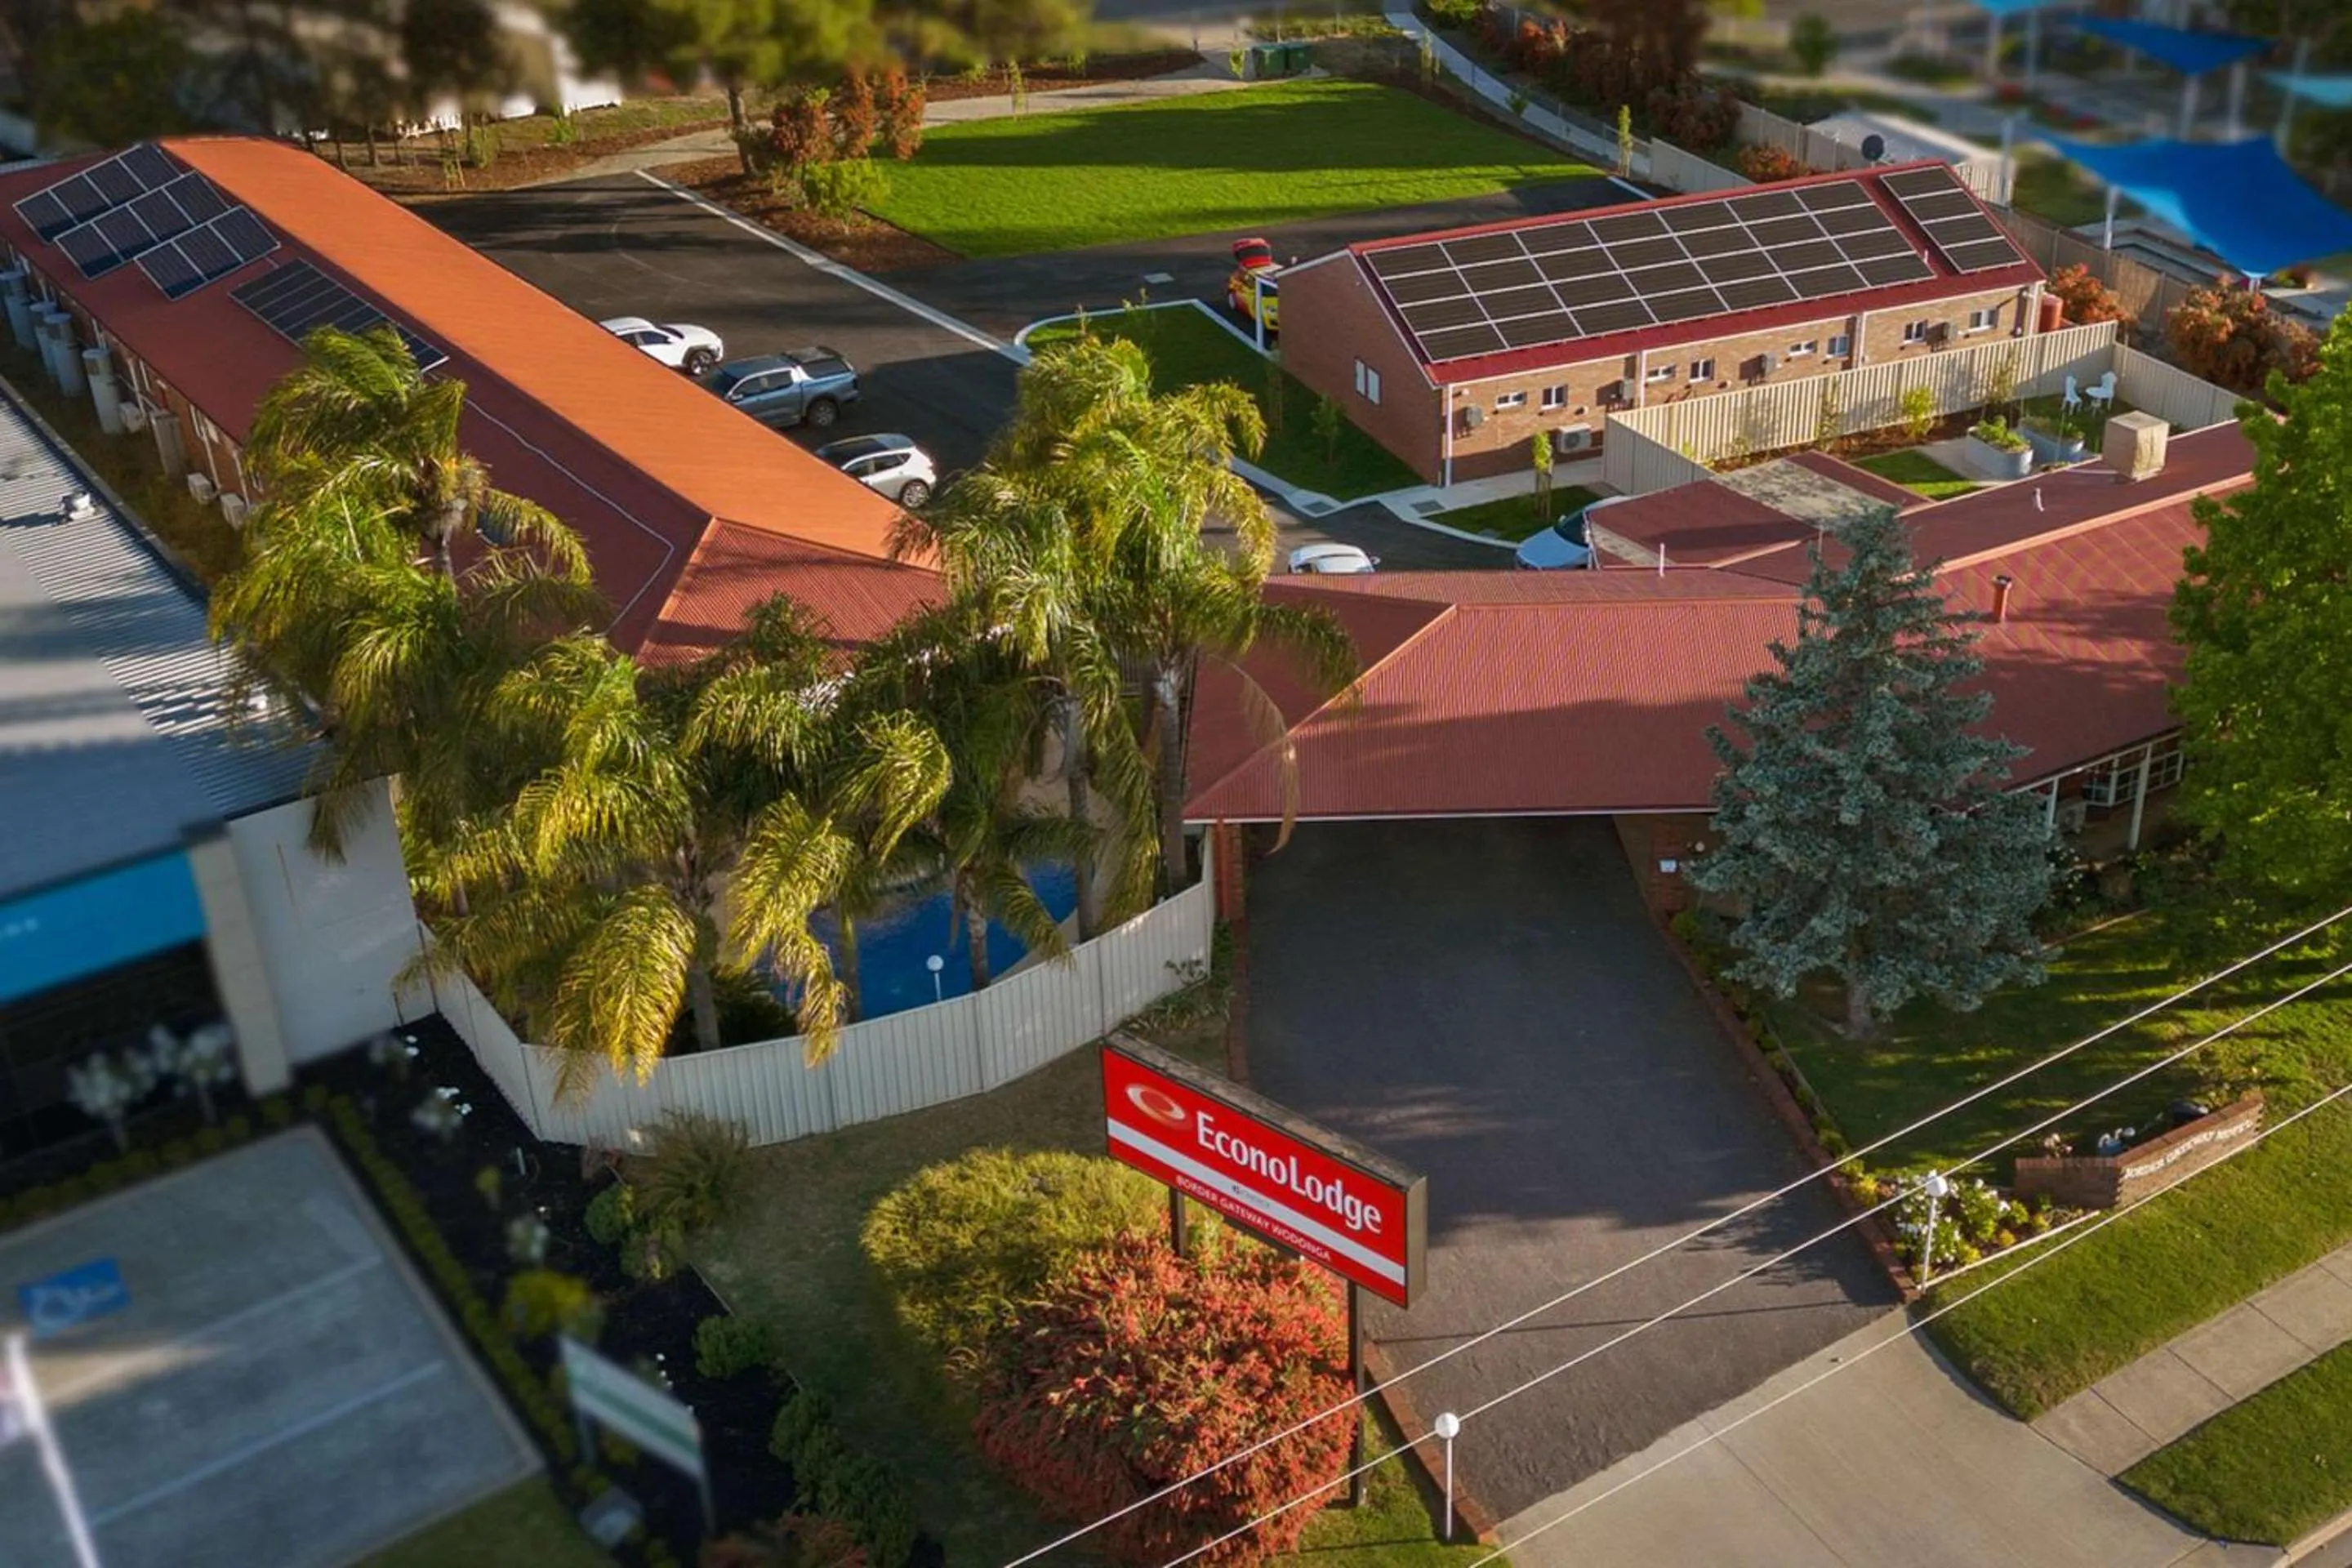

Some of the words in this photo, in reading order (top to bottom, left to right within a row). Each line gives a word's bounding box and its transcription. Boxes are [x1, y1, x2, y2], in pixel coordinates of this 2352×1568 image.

[1176, 1175, 1218, 1203] BORDER
[1219, 1195, 1269, 1230] GATEWAY
[1271, 1223, 1331, 1262] WODONGA
[1196, 1111, 1382, 1234] EconoLodge
